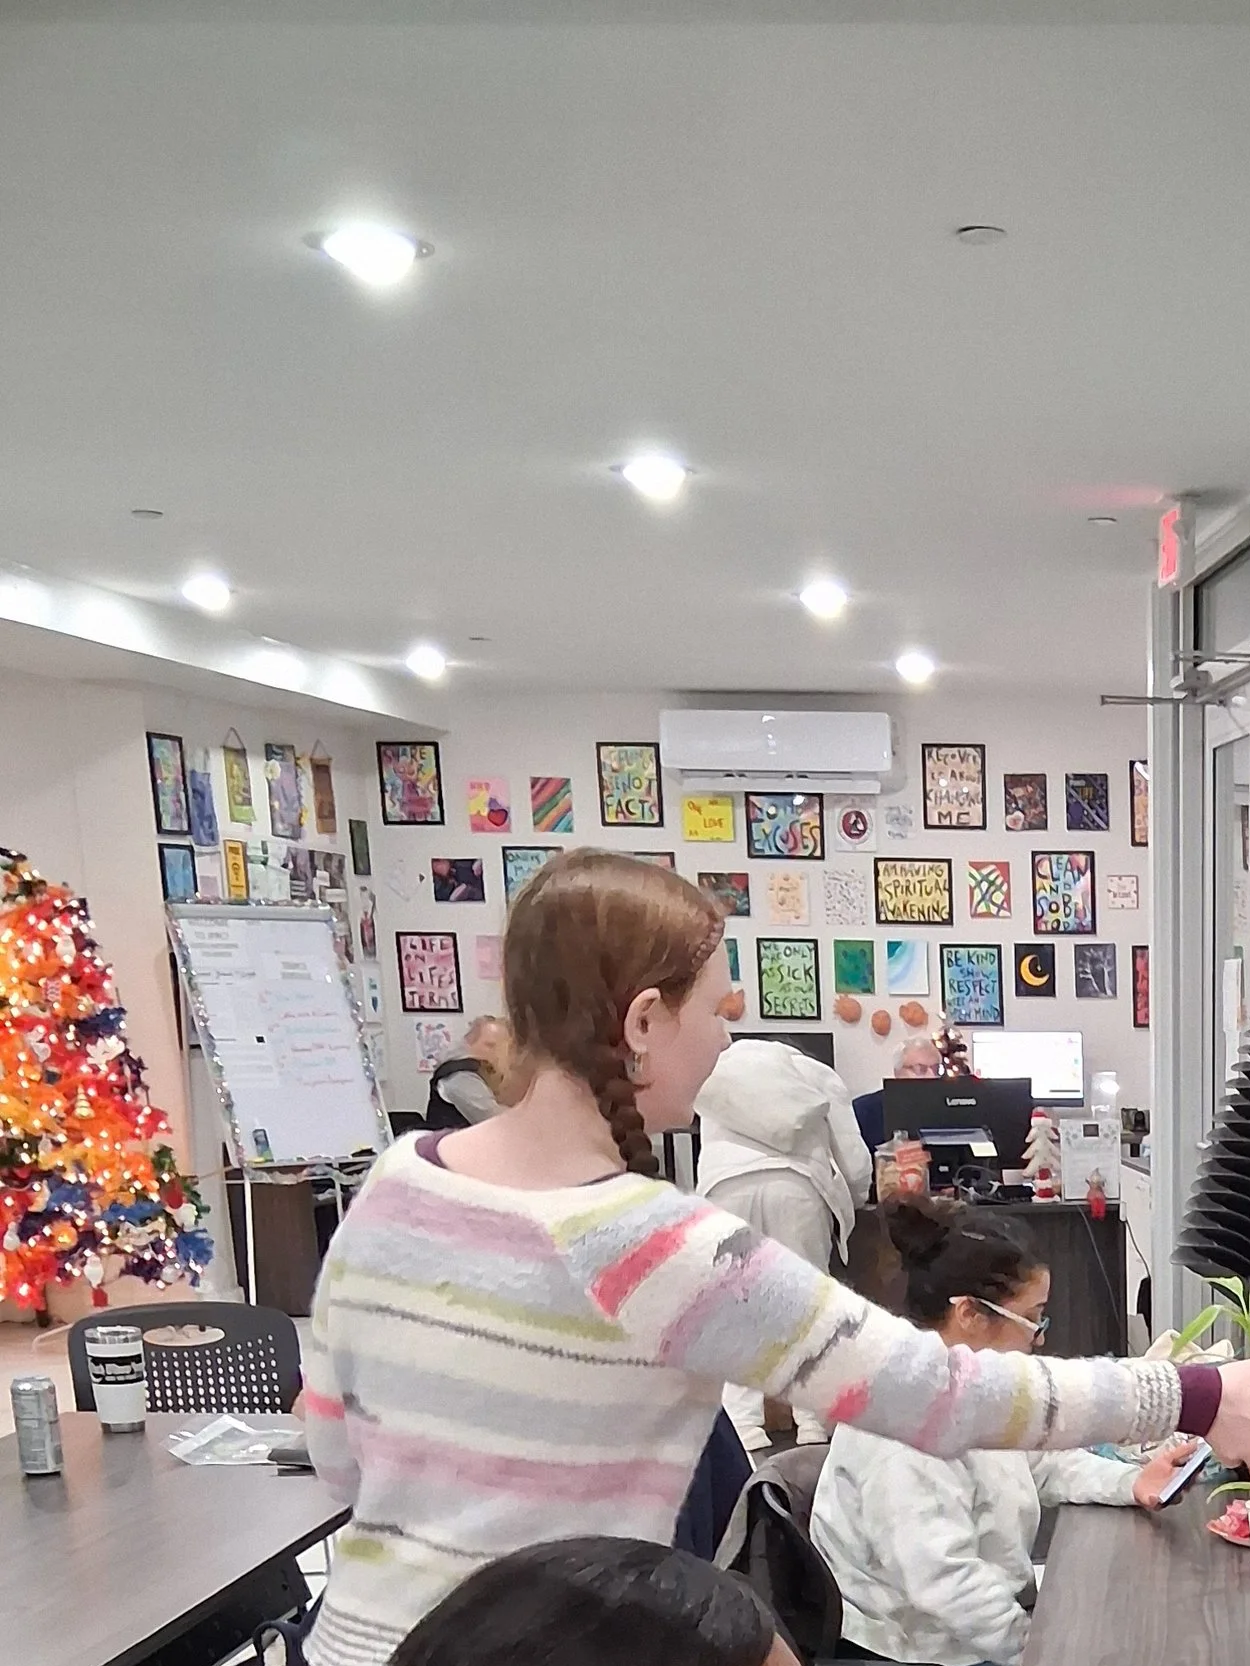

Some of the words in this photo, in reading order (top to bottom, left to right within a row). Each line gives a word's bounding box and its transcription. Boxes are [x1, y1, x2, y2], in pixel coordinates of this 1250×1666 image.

[605, 795, 656, 819] FACTS
[937, 811, 970, 825] ME
[751, 818, 821, 856] EXCUSES
[1036, 855, 1088, 884] CLEAN
[884, 878, 949, 901] SPIRITUAL
[1038, 882, 1072, 895] AND
[880, 899, 949, 921] AWAKENING
[409, 937, 452, 953] LIFE
[783, 945, 817, 960] ONLY
[404, 953, 426, 964] ON
[946, 950, 962, 968] BE
[967, 950, 996, 965] KIND
[777, 964, 813, 984] SICK
[948, 979, 997, 996] RESPECT
[765, 991, 815, 1016] SECRETS
